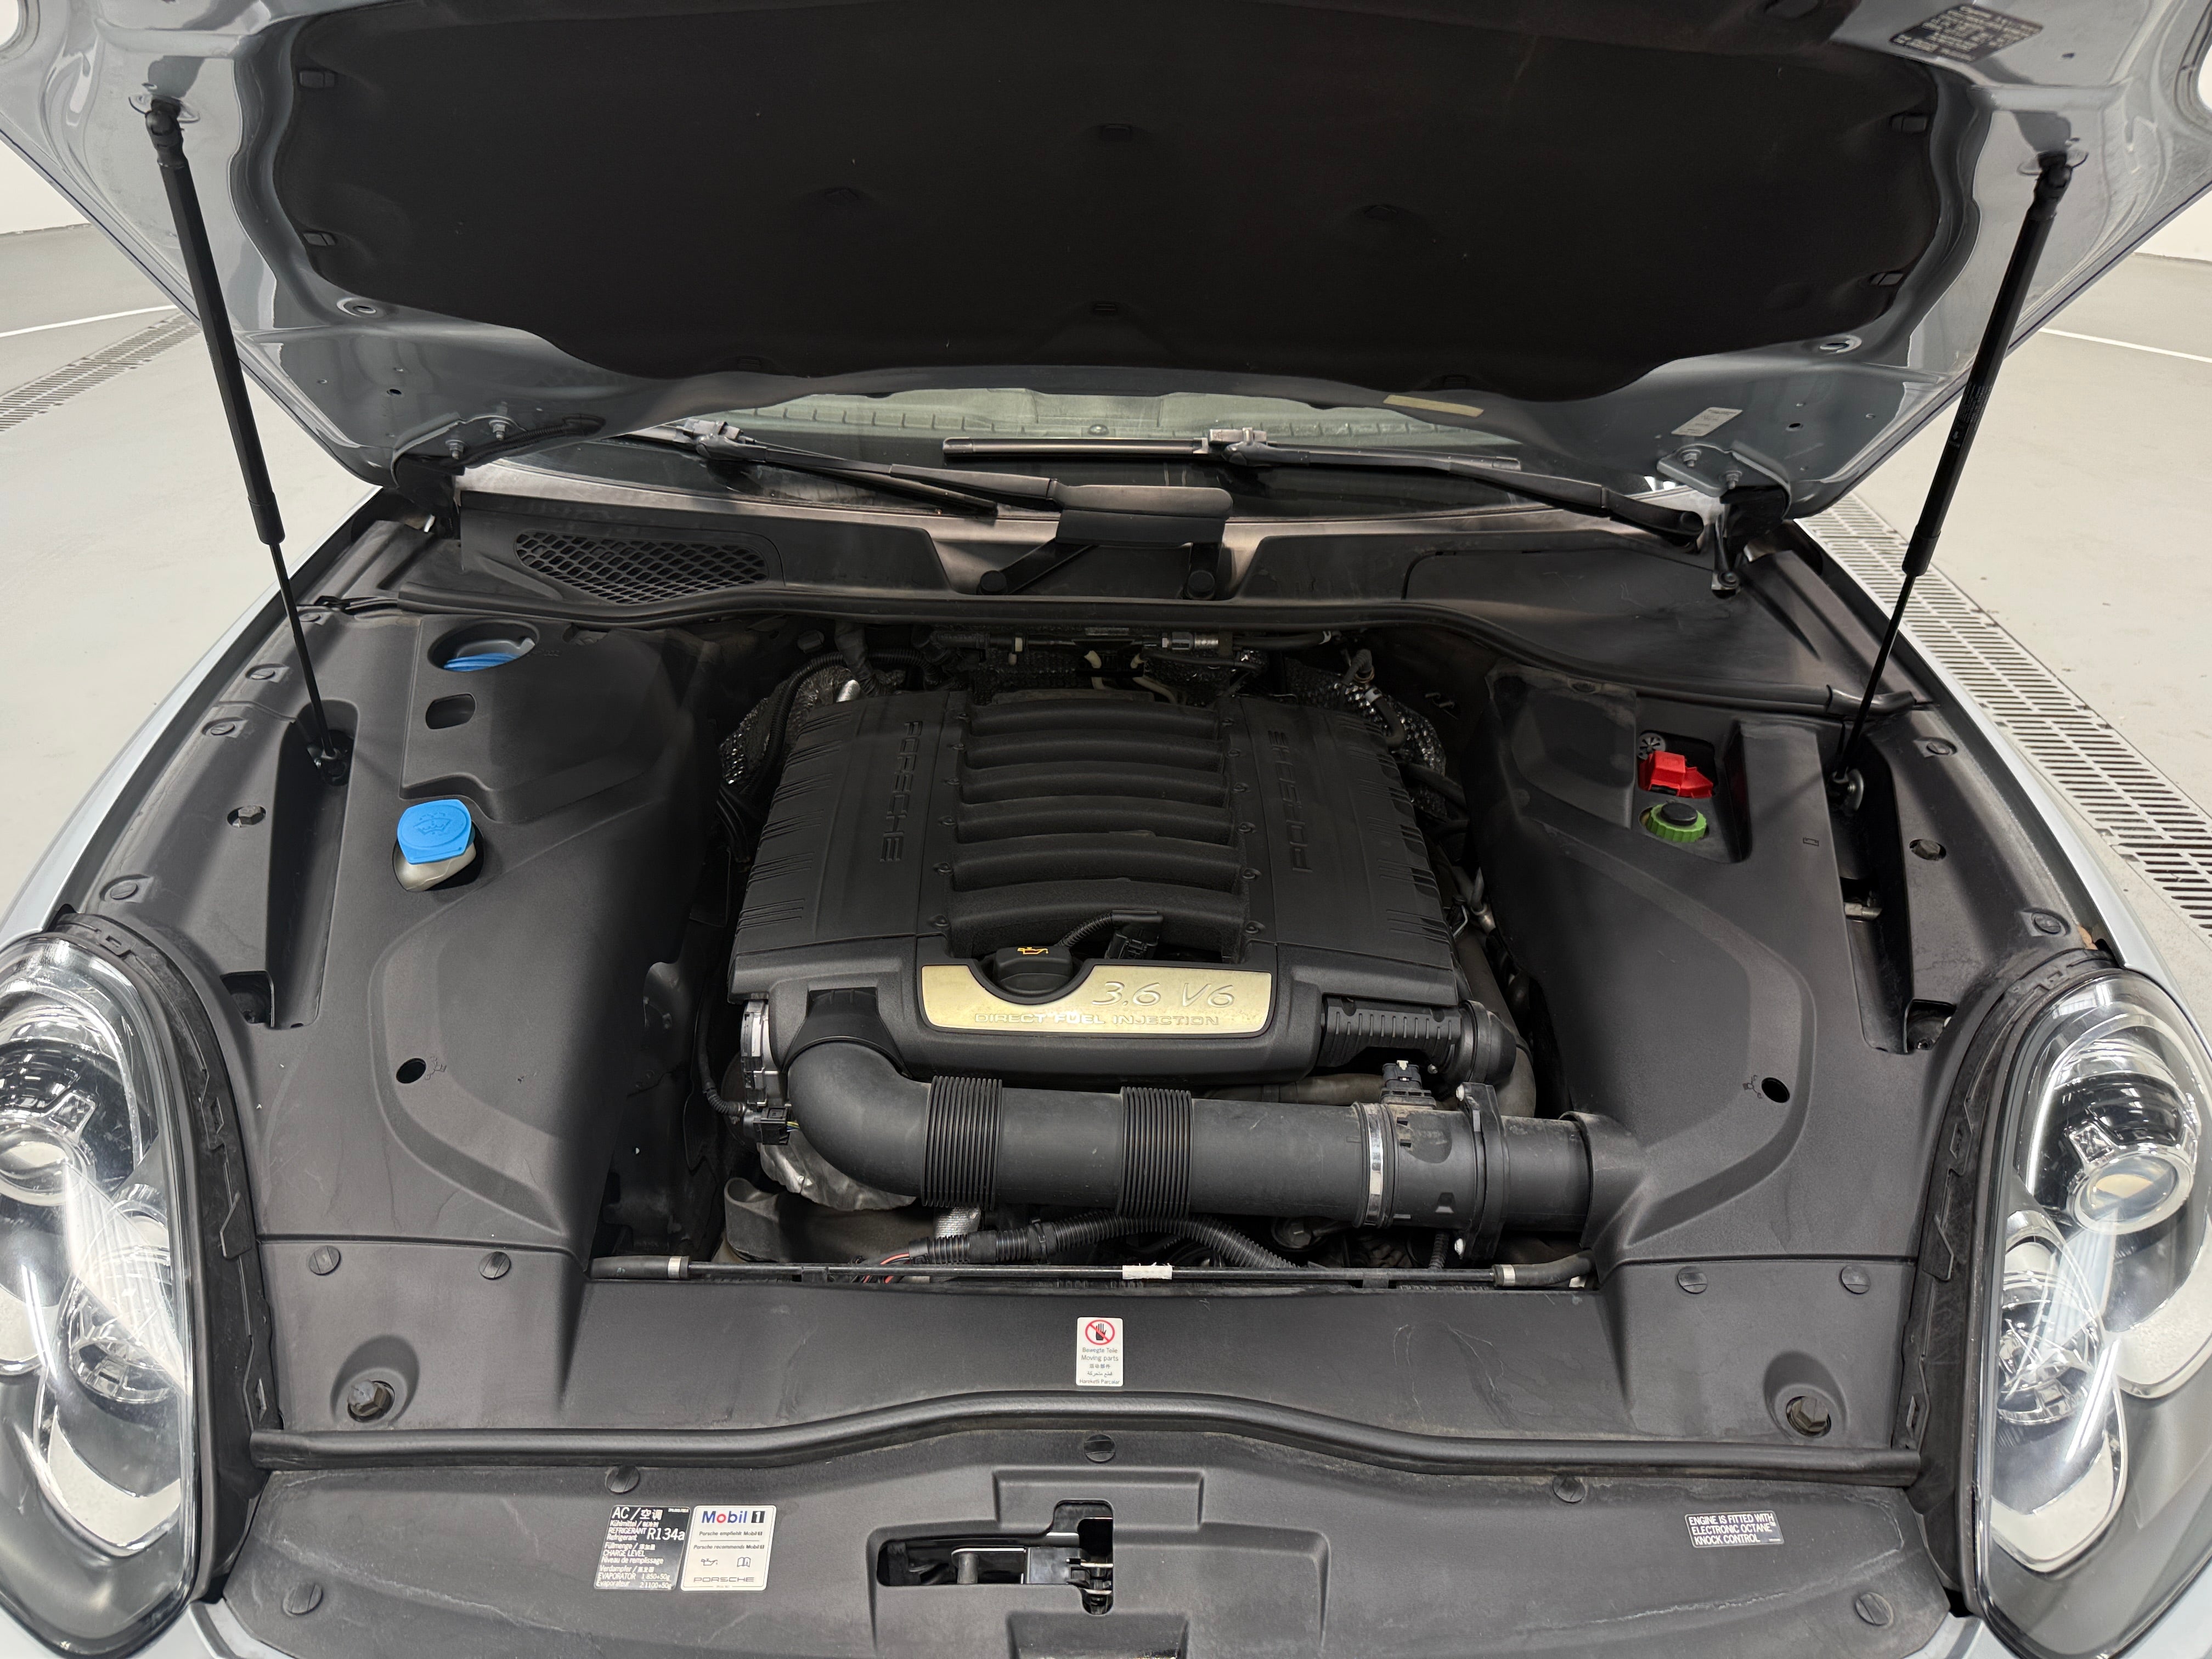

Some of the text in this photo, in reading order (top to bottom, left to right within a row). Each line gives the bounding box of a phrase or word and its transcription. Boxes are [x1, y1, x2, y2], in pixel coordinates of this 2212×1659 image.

[879, 721, 923, 862] PORSCHE
[1268, 731, 1312, 873] PORSCHE
[1092, 981, 1235, 1008] 3.6 V6
[975, 1013, 1219, 1026] DIRECT FUEL INJECTION
[612, 1506, 630, 1519] AC
[640, 1509, 663, 1520] 空调
[702, 1511, 748, 1523] Mobil
[1688, 1513, 1775, 1525] ENGINE IS FITTED WITH
[646, 1527, 685, 1541] R134a
[1691, 1525, 1739, 1535] ELECTRONIC
[1694, 1534, 1760, 1545] KNOCK CONTROL
[605, 1542, 633, 1551] Füllmenge
[629, 1557, 664, 1565] remplissage
